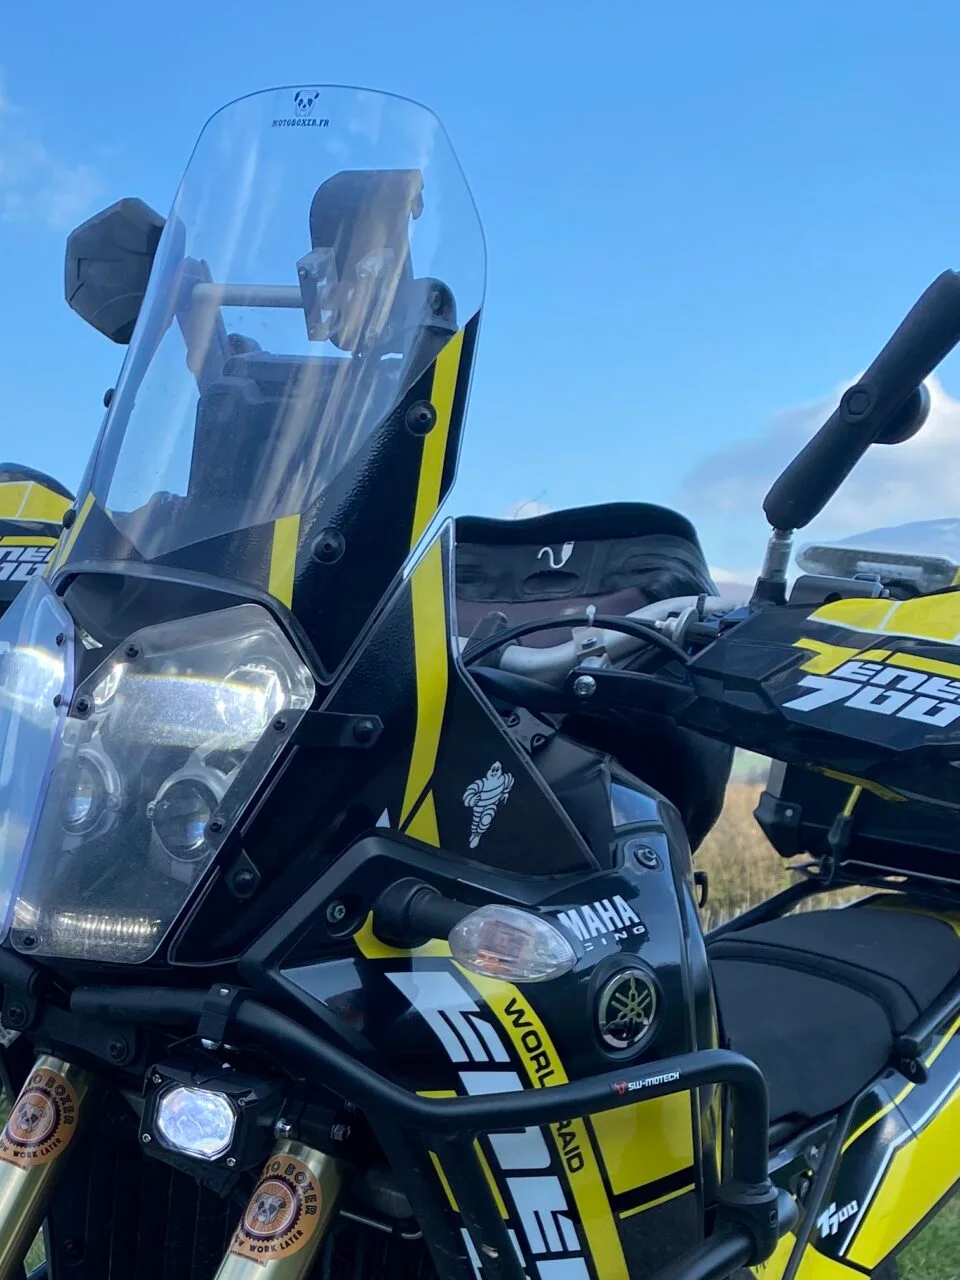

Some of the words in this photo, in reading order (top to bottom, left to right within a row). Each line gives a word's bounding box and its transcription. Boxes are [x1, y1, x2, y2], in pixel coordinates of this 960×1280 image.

[271, 118, 330, 127] MOTOBOXER.FR
[557, 894, 641, 942] MAHA
[503, 996, 555, 1089] WORL
[628, 1071, 680, 1092] SW-MOTECH
[45, 1076, 75, 1125] BOXER
[13, 1149, 38, 1159] WORK
[40, 1137, 62, 1156] LATER
[284, 1162, 318, 1216] BOXER
[249, 1244, 277, 1253] WORK
[280, 1229, 304, 1250] LATER
